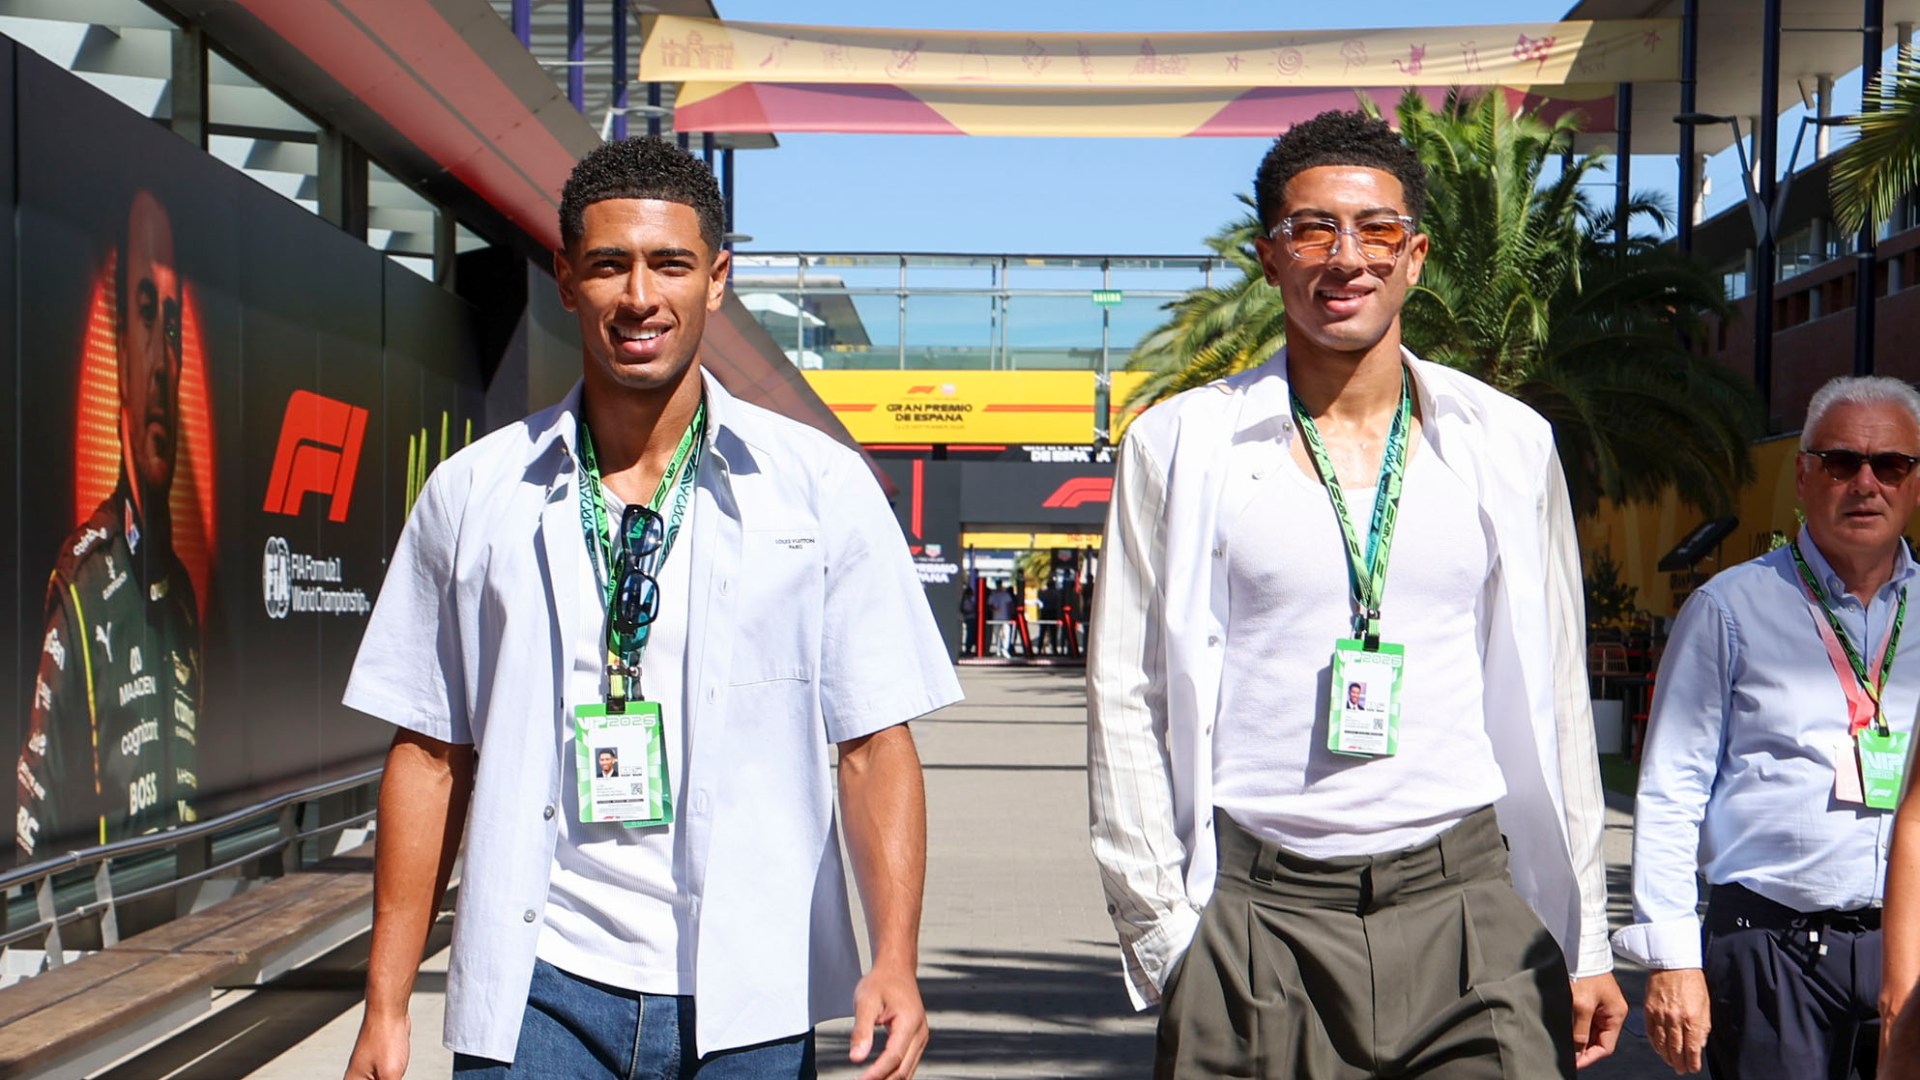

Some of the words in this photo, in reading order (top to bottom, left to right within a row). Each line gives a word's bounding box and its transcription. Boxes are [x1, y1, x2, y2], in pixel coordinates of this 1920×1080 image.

[1093, 292, 1121, 302] SALIDA
[886, 404, 922, 412] GRAN
[924, 404, 973, 412] PREMIO
[895, 413, 912, 421] DE
[263, 389, 369, 522] F1
[1031, 451, 1051, 462] DE
[665, 462, 677, 479] VIP
[291, 553, 306, 580] FIA
[305, 554, 335, 582] Formula
[291, 586, 316, 612] World
[316, 586, 365, 617] Championship
[119, 676, 157, 707] MAADEN
[607, 714, 657, 728] 2026
[121, 717, 159, 756] cognizant
[129, 772, 157, 816] BOSS
